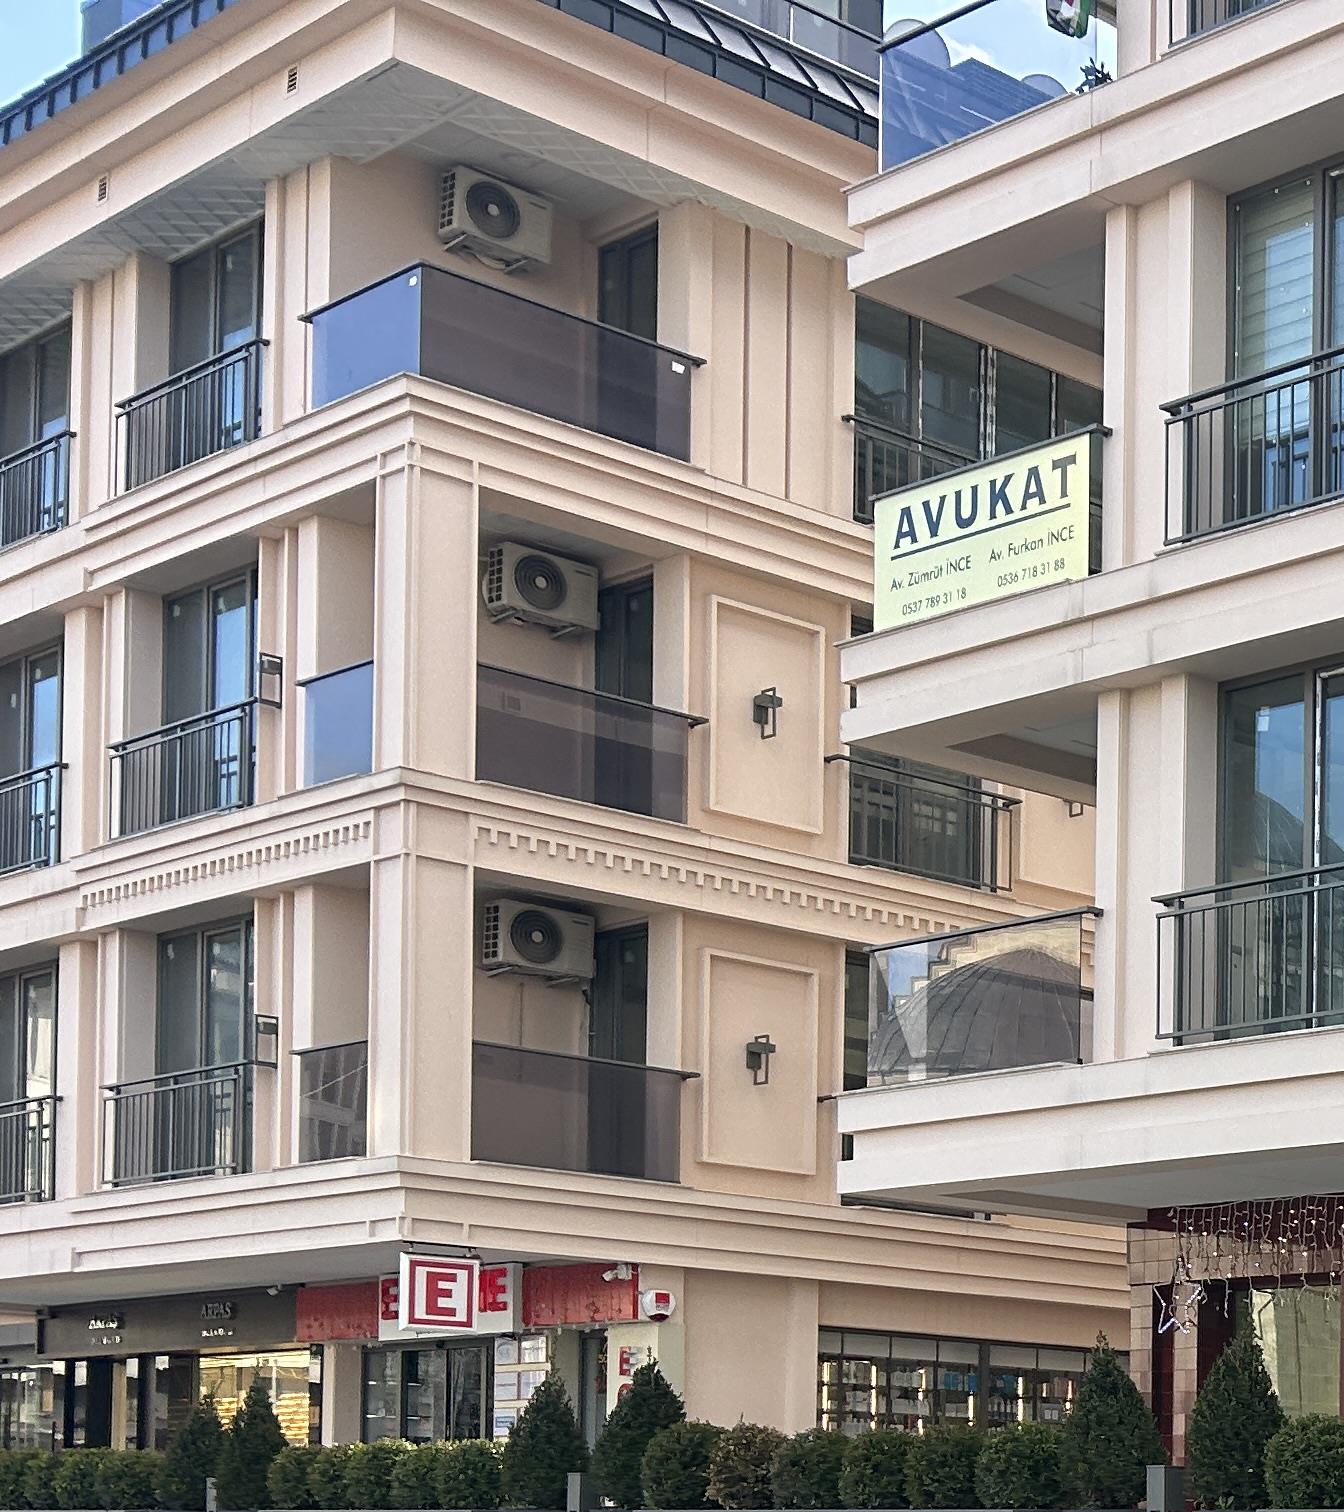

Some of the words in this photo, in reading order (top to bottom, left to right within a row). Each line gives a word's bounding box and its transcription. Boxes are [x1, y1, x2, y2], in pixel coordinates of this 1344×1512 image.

[893, 452, 1077, 550] AVUKAT
[989, 549, 1003, 563] Av.
[1008, 536, 1044, 558] Furkan
[1048, 525, 1075, 547] İNCE
[890, 577, 904, 592] Av.
[908, 566, 944, 588] Zümrüt
[946, 554, 972, 577] İNCE
[997, 571, 1019, 588] 0536
[1022, 566, 1039, 579] 718
[1040, 562, 1051, 575] 31
[1054, 558, 1066, 571] 88
[902, 601, 922, 616] 0537
[925, 596, 941, 610] 789
[943, 591, 953, 604] 31
[957, 587, 967, 600] 18
[426, 1271, 458, 1317] E
